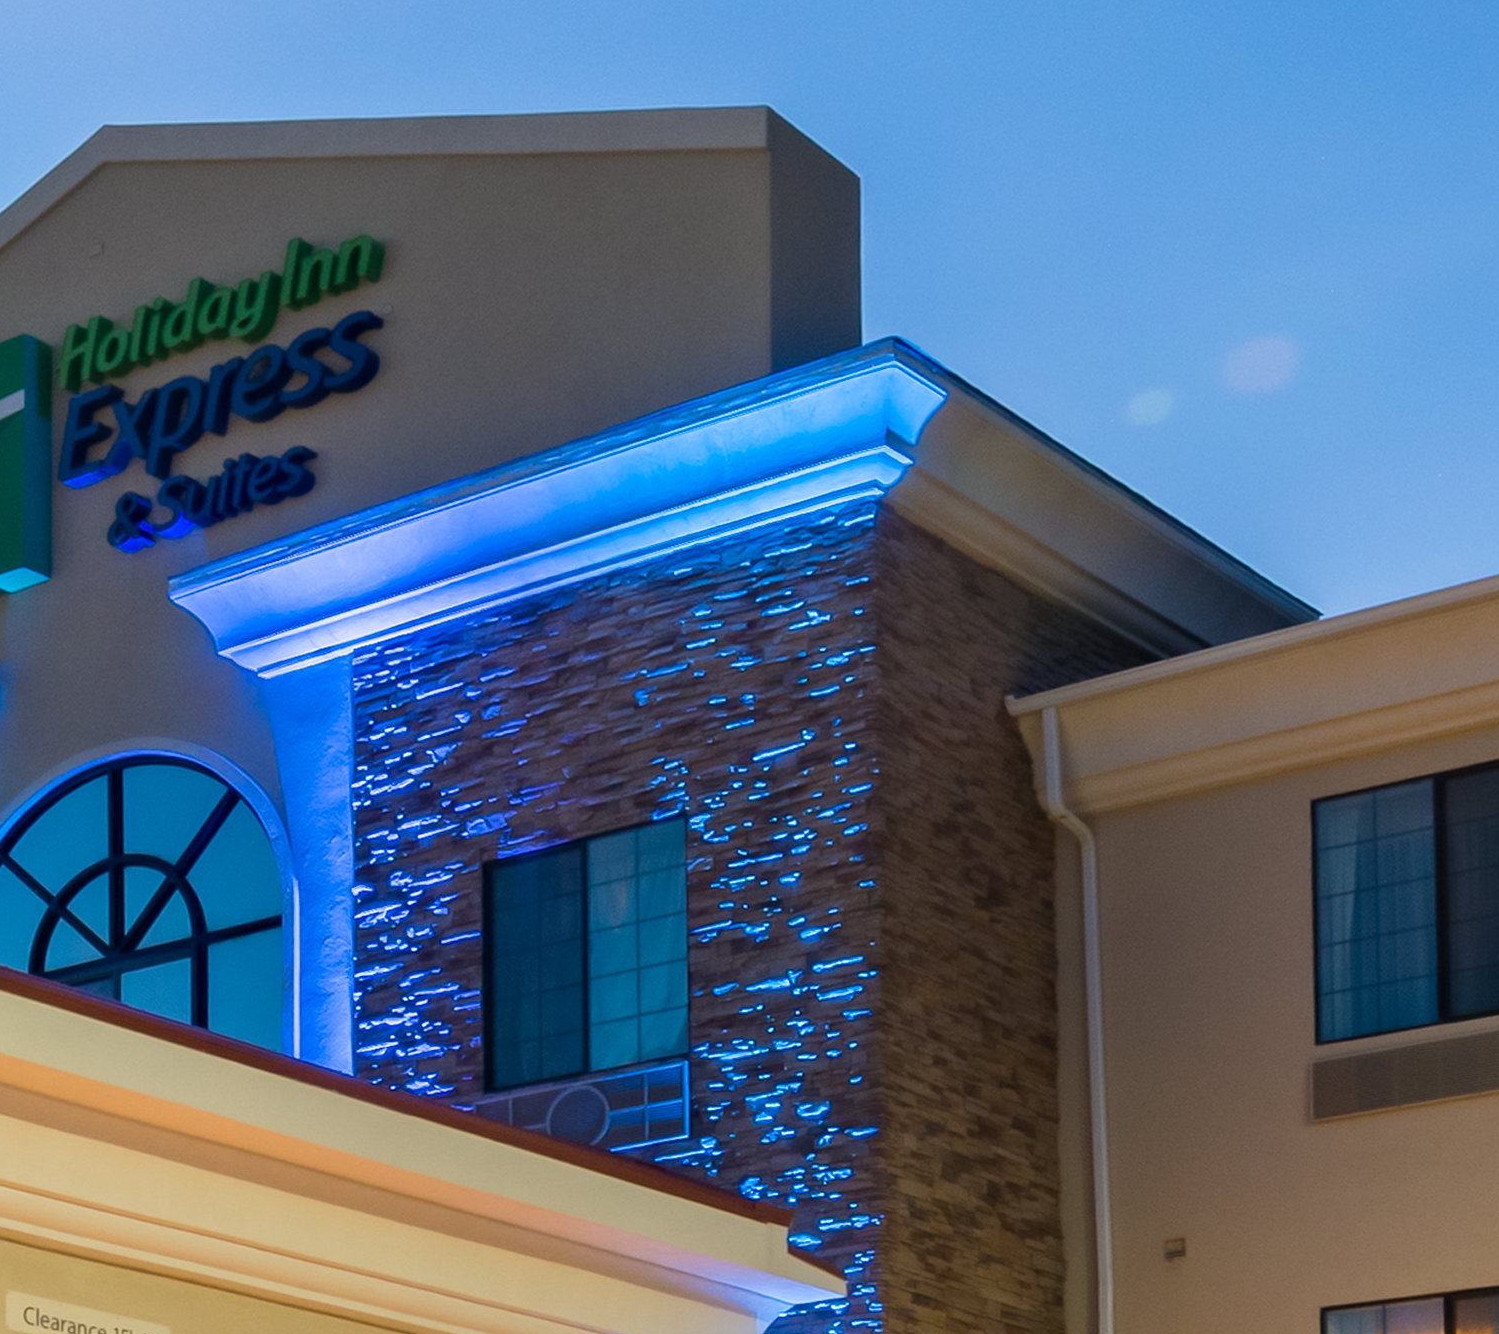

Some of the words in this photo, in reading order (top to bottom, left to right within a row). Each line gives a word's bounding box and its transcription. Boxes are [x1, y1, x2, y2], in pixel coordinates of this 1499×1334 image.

[59, 270, 279, 391] Holiday
[280, 234, 384, 310] Inn
[58, 310, 383, 488] Express
[107, 491, 156, 554] &
[157, 445, 317, 540] Suites
